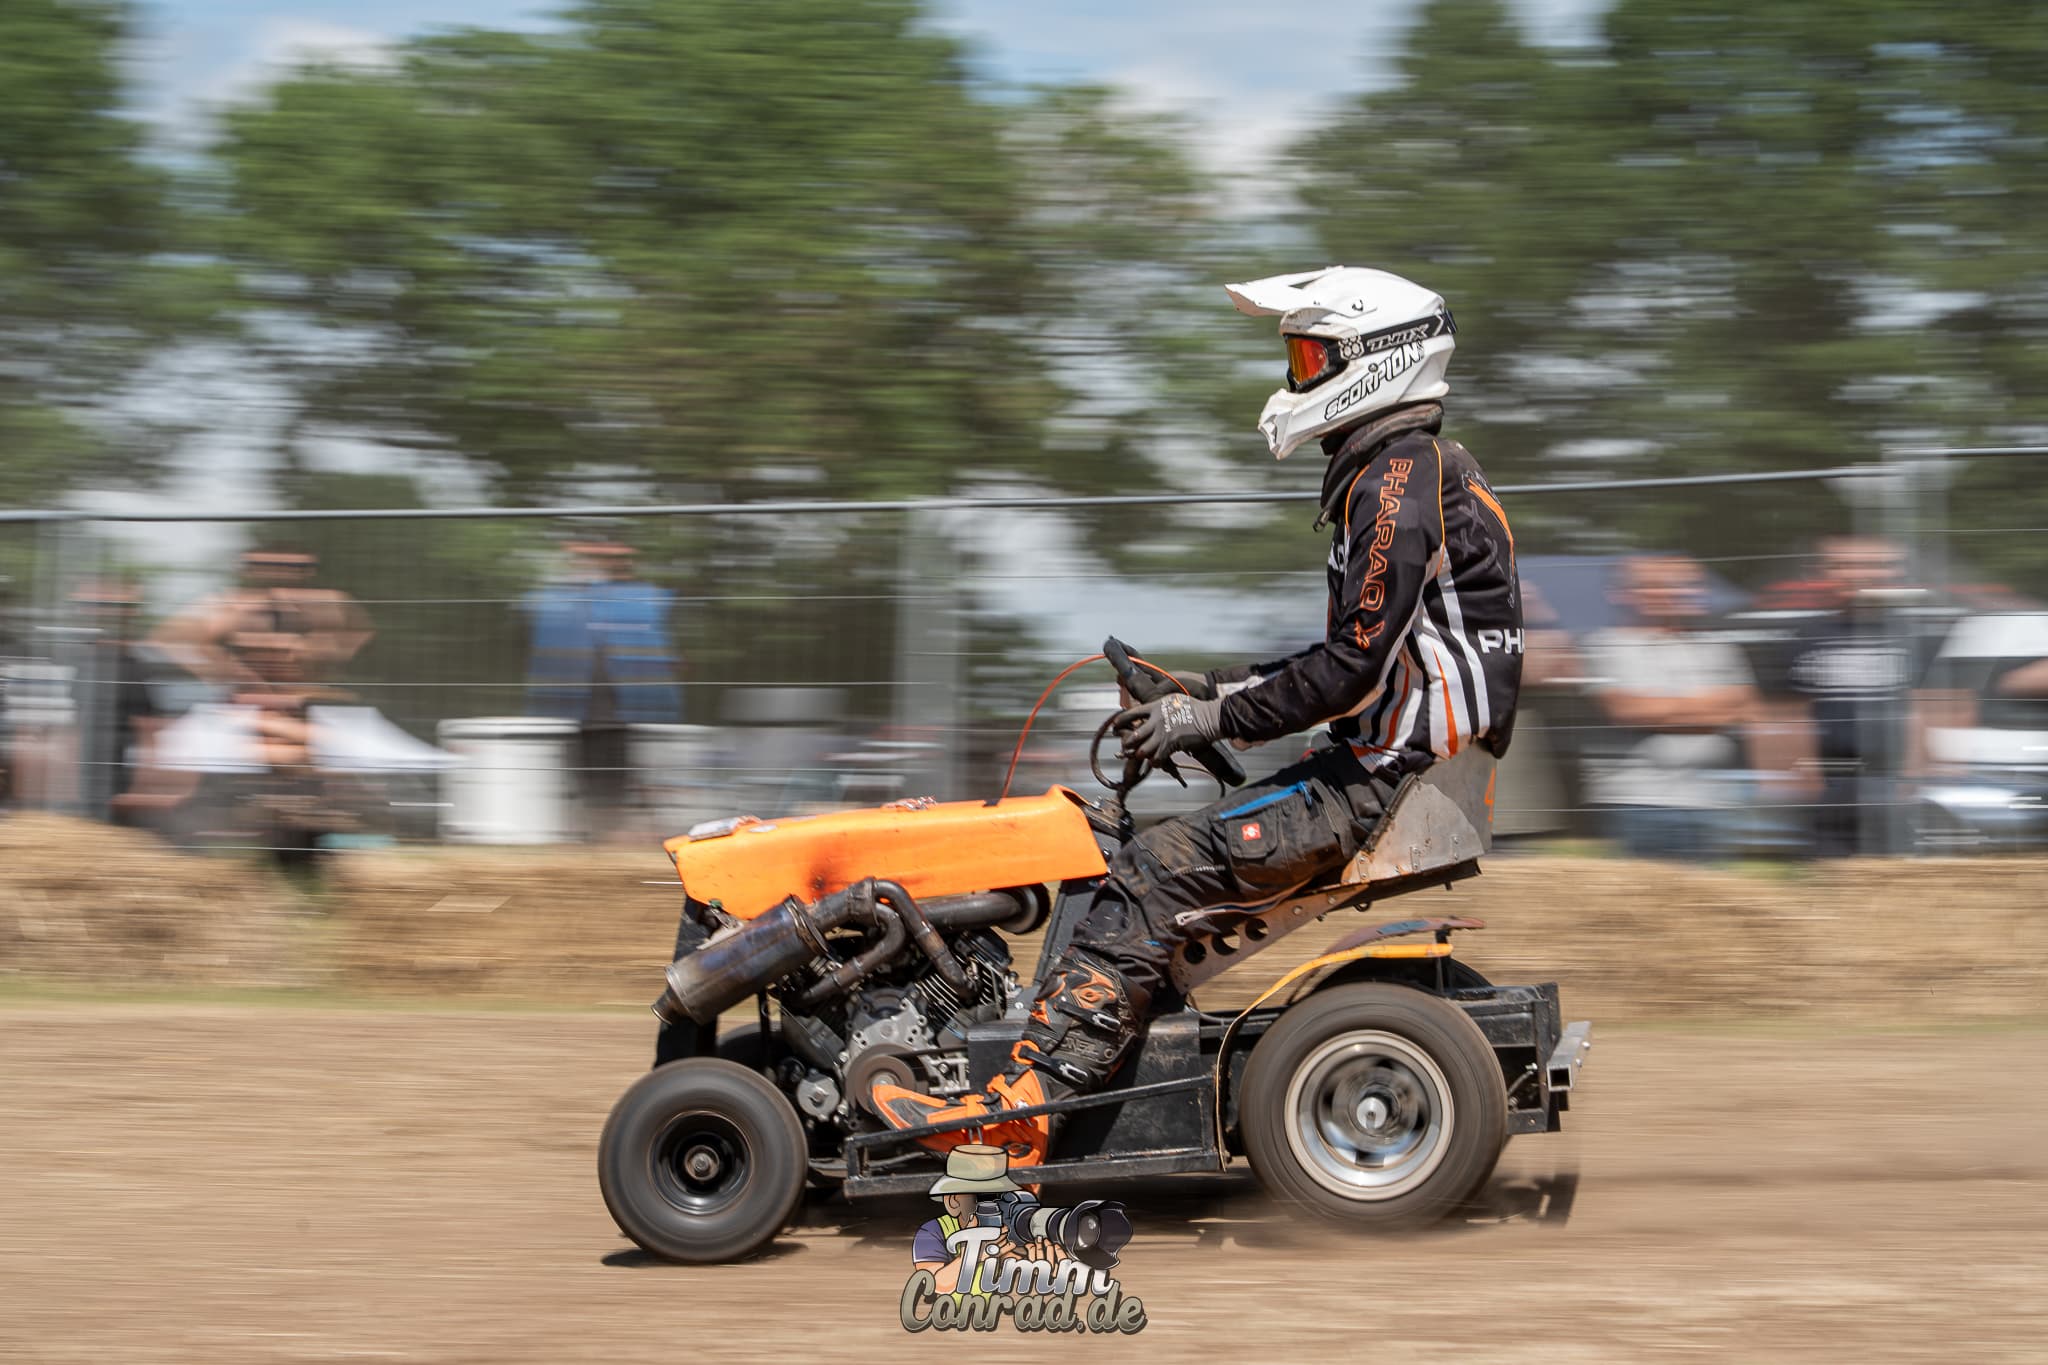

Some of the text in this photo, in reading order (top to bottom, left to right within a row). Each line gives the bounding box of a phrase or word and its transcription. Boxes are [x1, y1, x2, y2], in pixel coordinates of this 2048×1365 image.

[1324, 341, 1423, 421] SCORPION
[1360, 457, 1414, 612] PHARAO
[1477, 628, 1525, 654] PH
